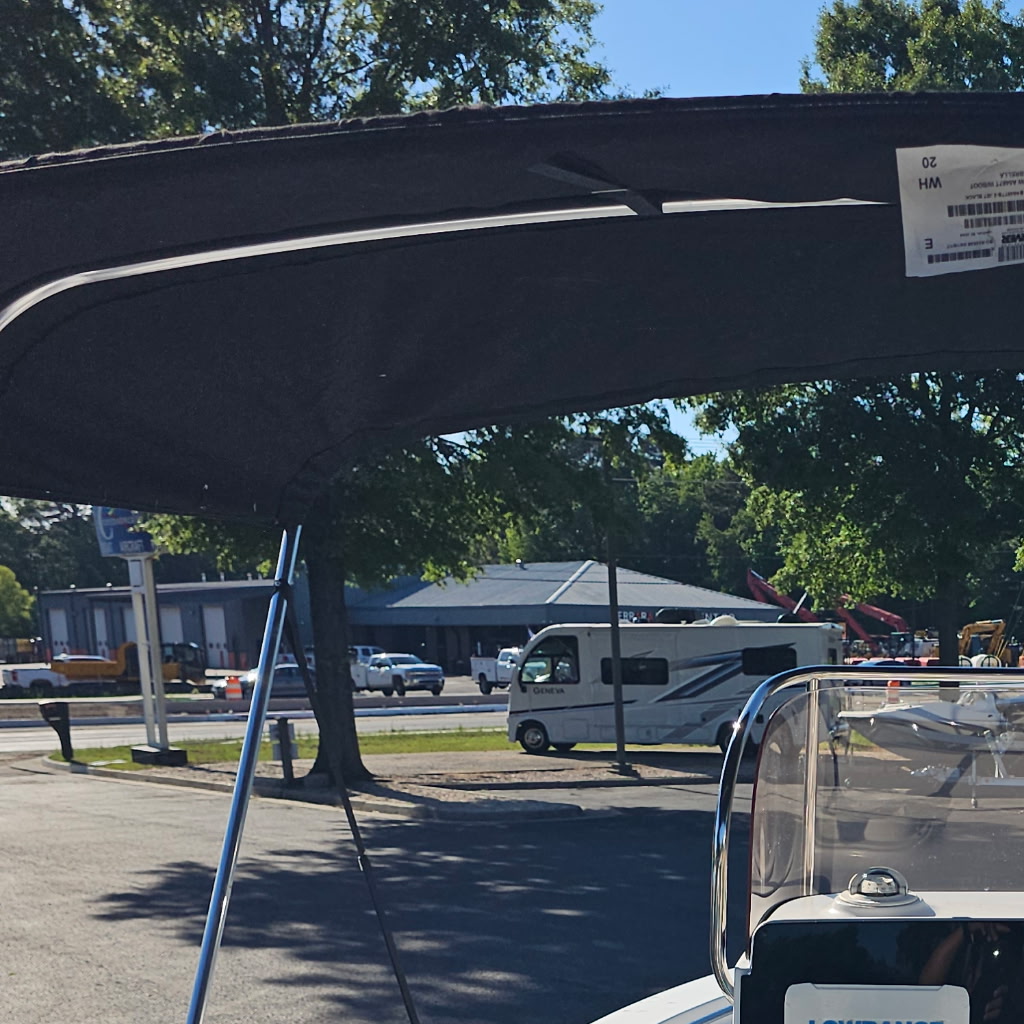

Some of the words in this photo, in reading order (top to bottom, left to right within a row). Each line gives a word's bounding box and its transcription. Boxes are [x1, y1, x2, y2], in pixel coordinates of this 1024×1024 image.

[922, 156, 937, 168] 20
[918, 176, 942, 190] WH
[924, 238, 933, 249] E
[533, 686, 565, 695] GENEVA
